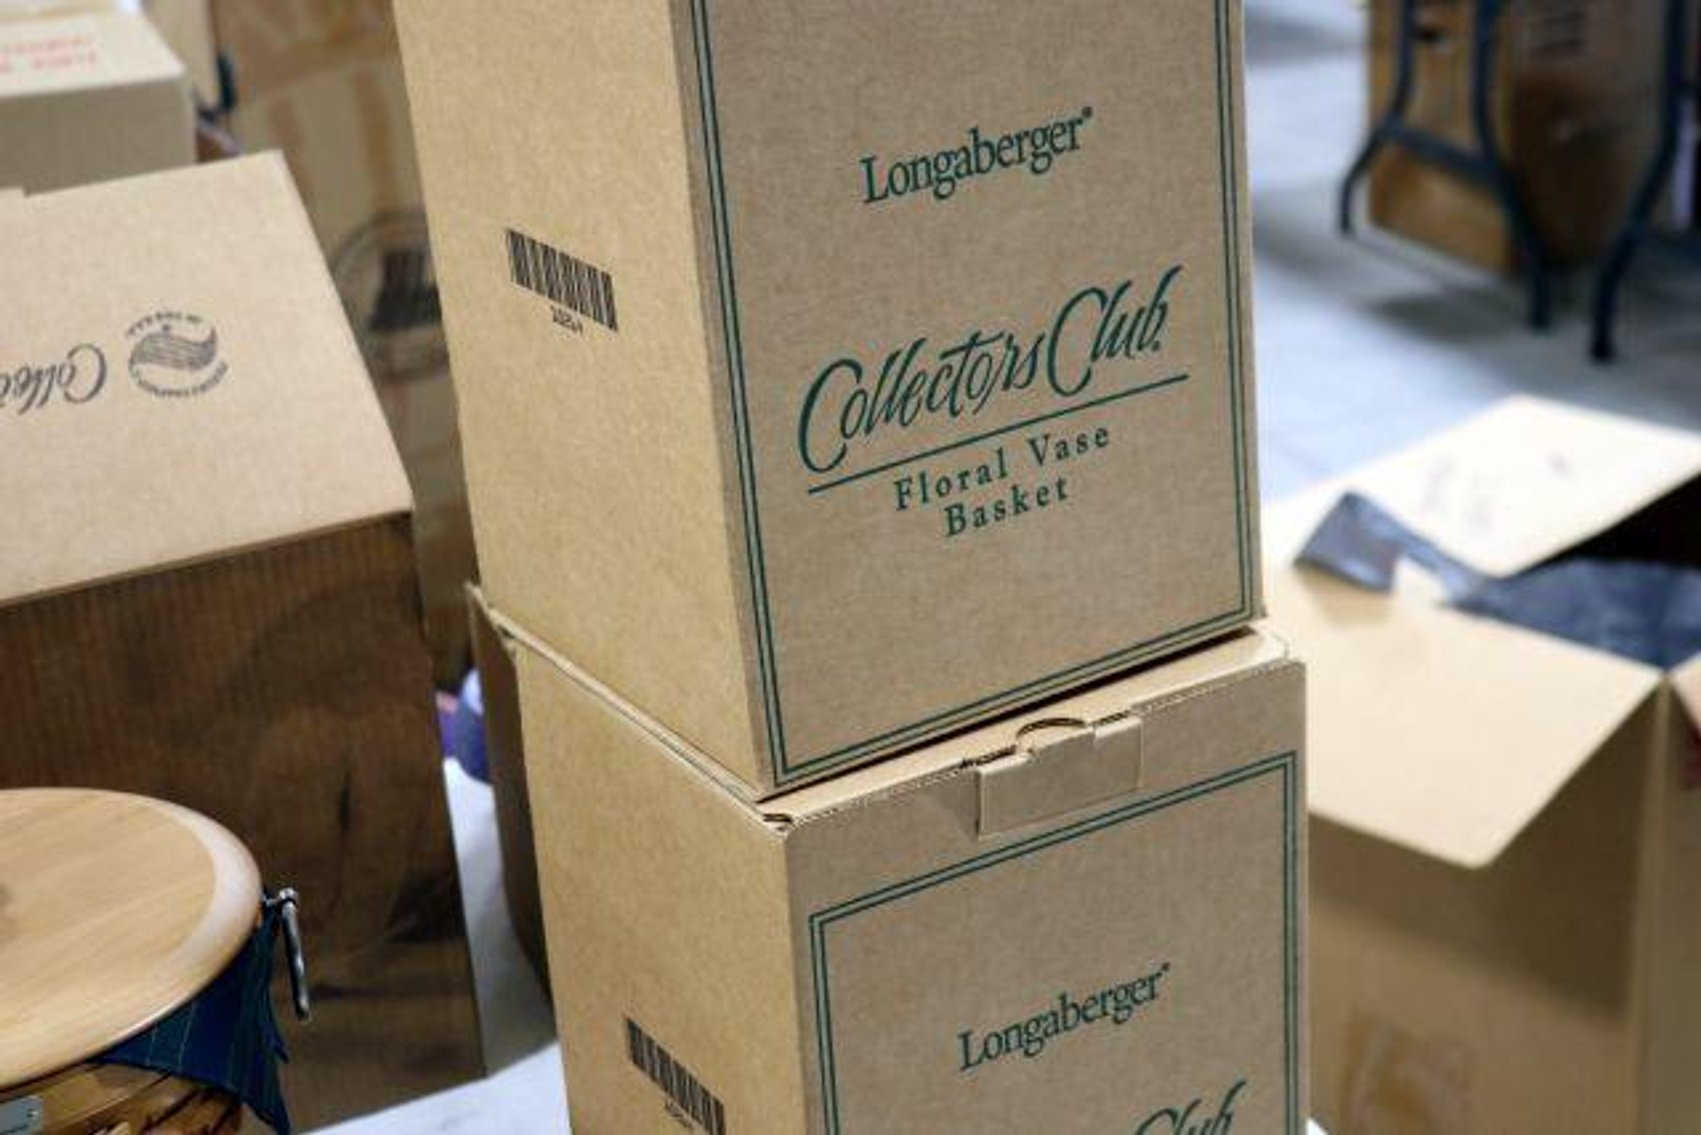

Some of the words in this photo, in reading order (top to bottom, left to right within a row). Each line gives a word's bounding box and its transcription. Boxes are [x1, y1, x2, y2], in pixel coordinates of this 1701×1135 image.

[799, 330, 1046, 473] Collectors
[893, 449, 1009, 511] Floral
[1025, 427, 1110, 467] Vase
[943, 478, 1069, 538] Basket
